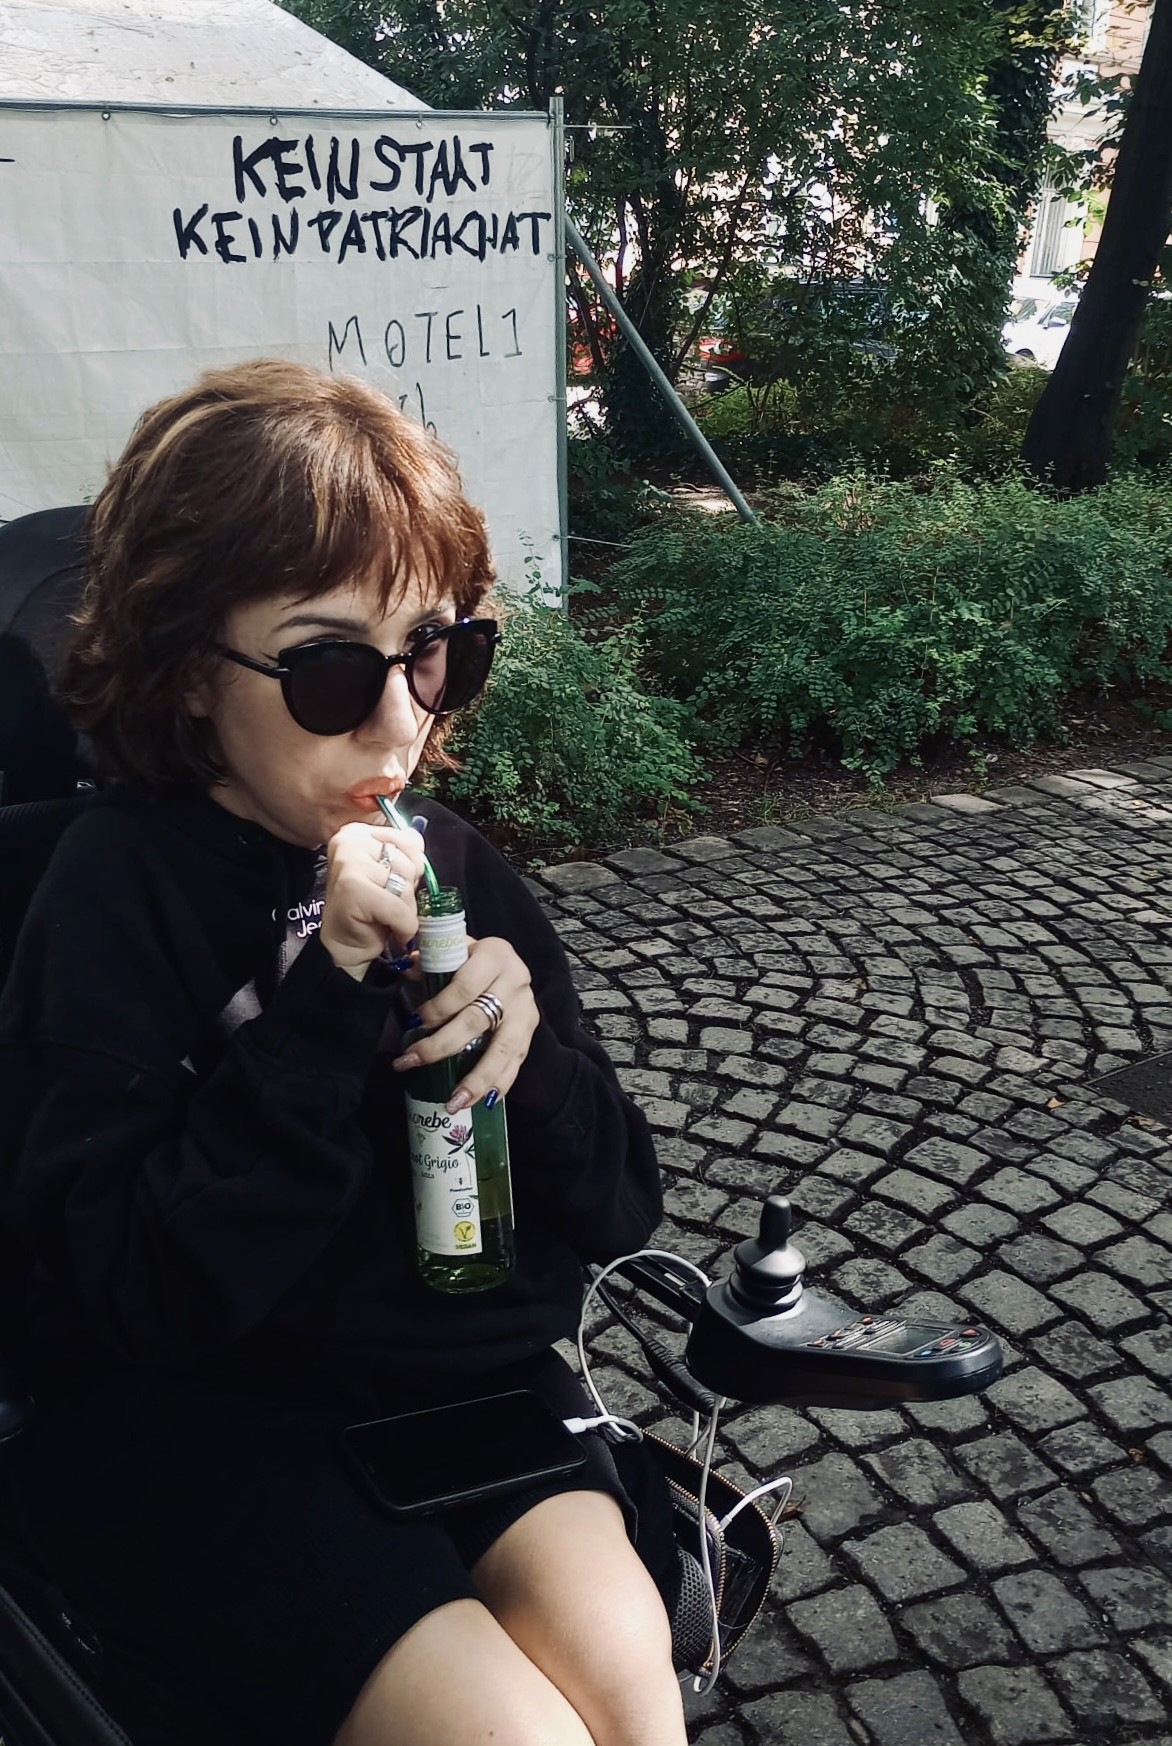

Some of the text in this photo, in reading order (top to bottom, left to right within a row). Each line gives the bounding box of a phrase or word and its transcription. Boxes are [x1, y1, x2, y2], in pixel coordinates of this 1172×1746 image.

[232, 134, 494, 203] KEIN STAAT
[172, 203, 299, 264] KEIN
[424, 1153, 459, 1173] Grigio
[455, 1202, 471, 1211] BIO
